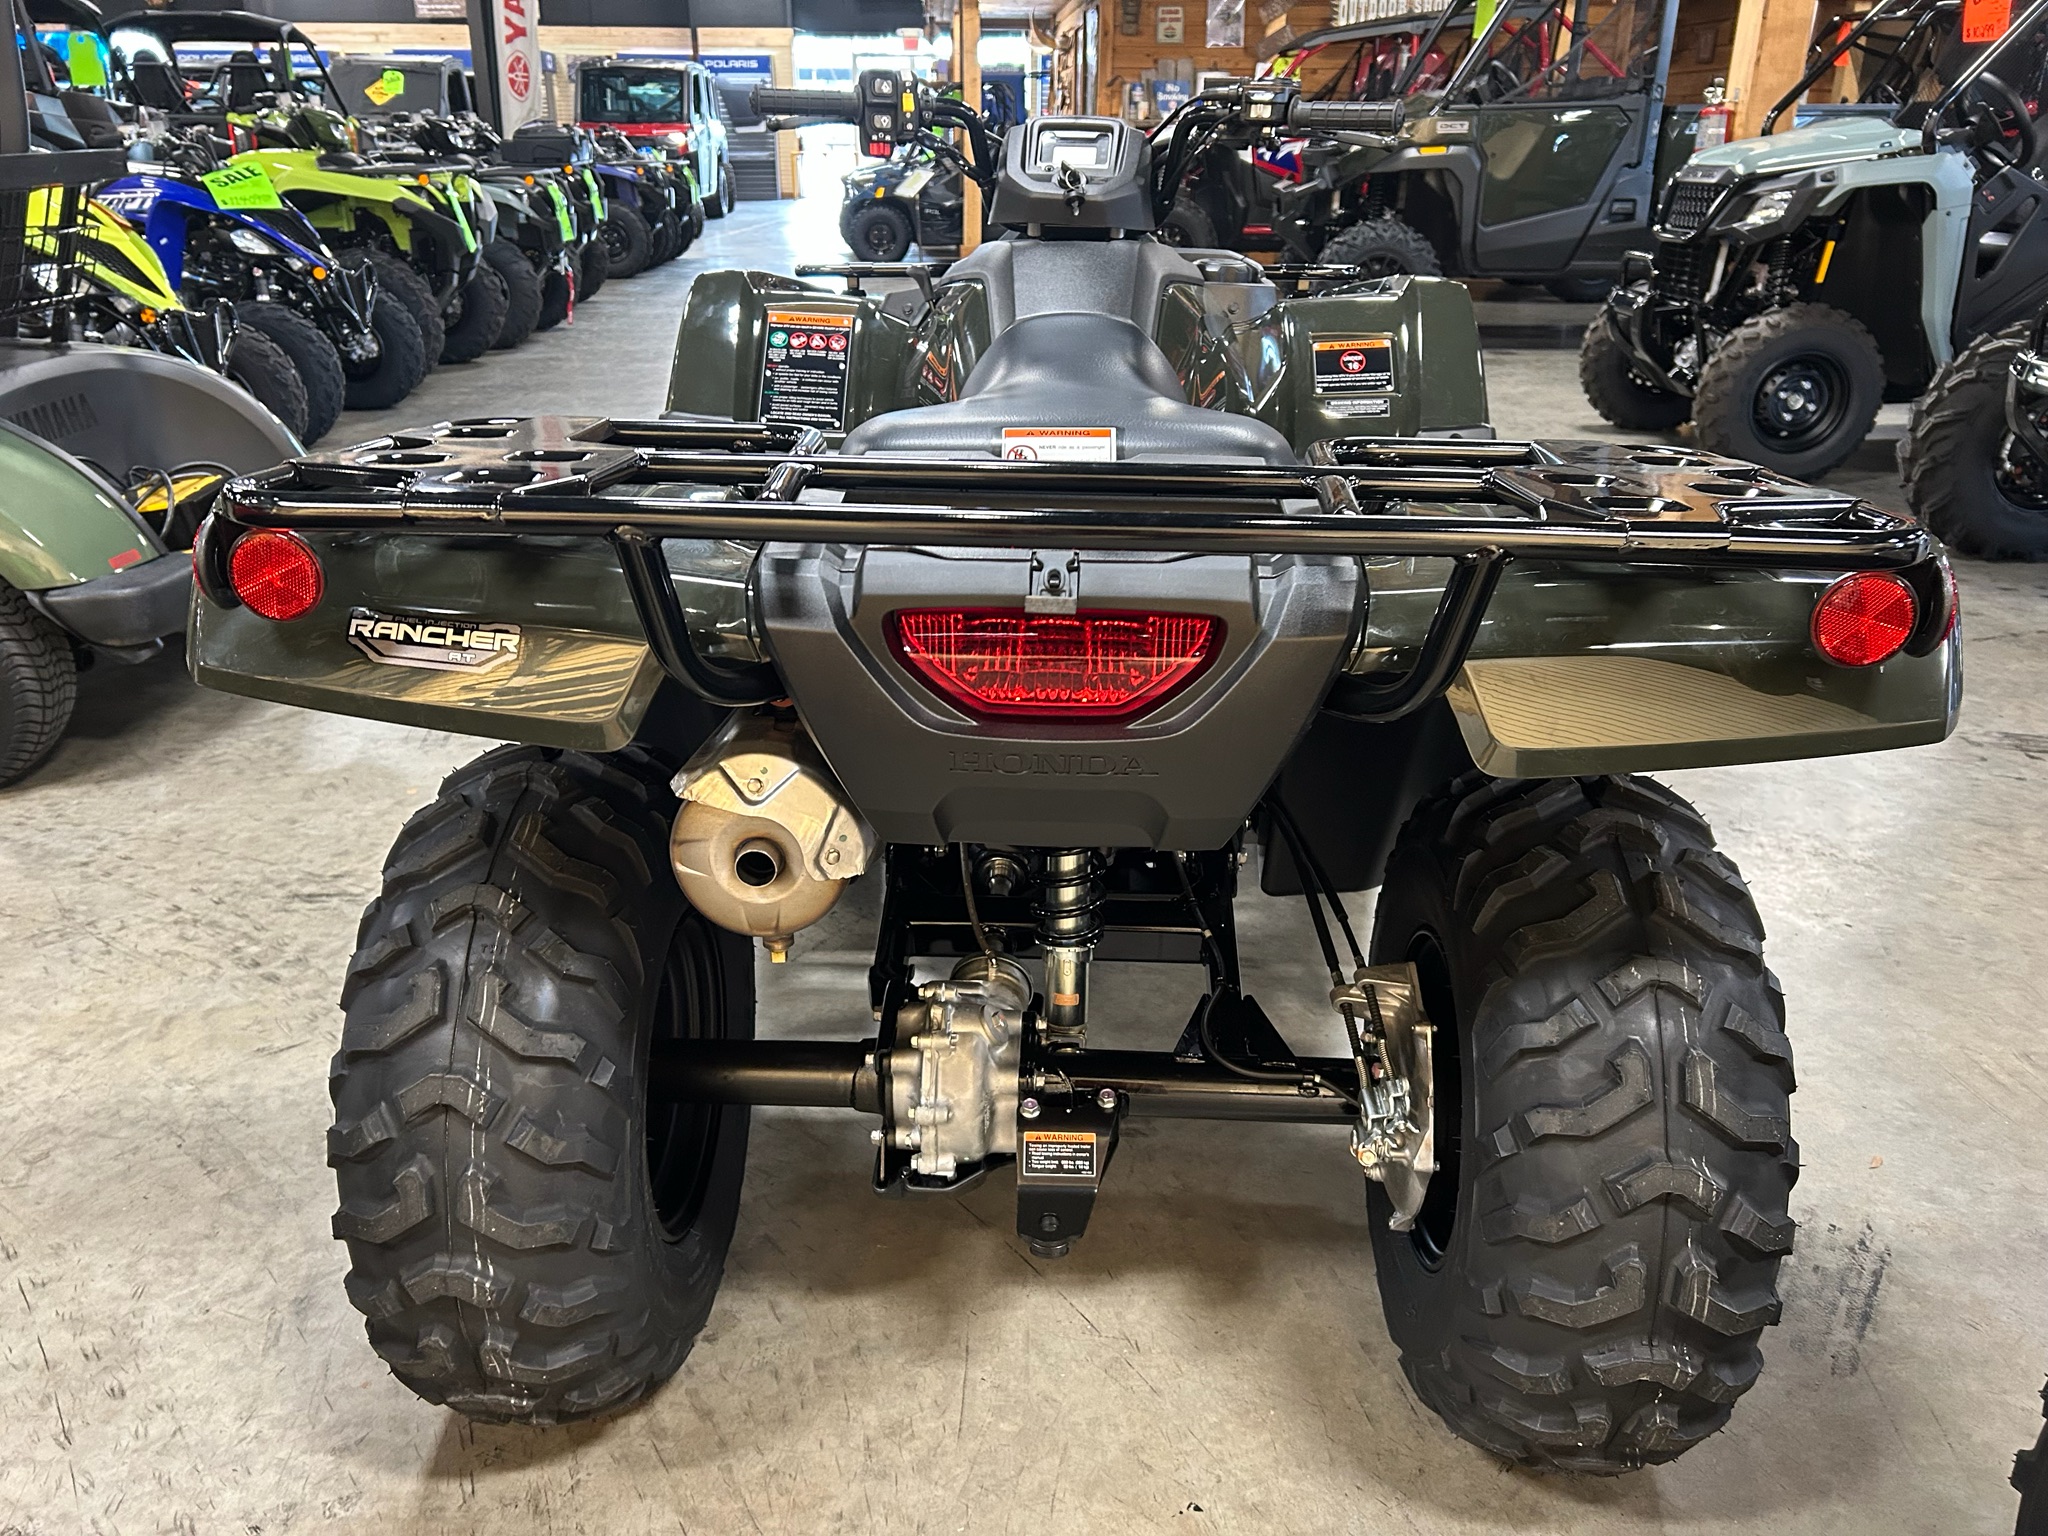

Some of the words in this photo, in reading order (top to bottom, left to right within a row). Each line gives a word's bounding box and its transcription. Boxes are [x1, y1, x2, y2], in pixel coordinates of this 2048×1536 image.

[704, 59, 759, 69] POLARIS
[1165, 83, 1181, 92] No
[1157, 92, 1189, 102] Smoking
[209, 166, 263, 188] SALE
[1348, 362, 1359, 370] 16
[395, 615, 422, 625] FUEL
[424, 617, 478, 630] INJECTION
[348, 618, 520, 653] RANCHER
[448, 652, 477, 663] AT
[949, 751, 1160, 777] HONDA
